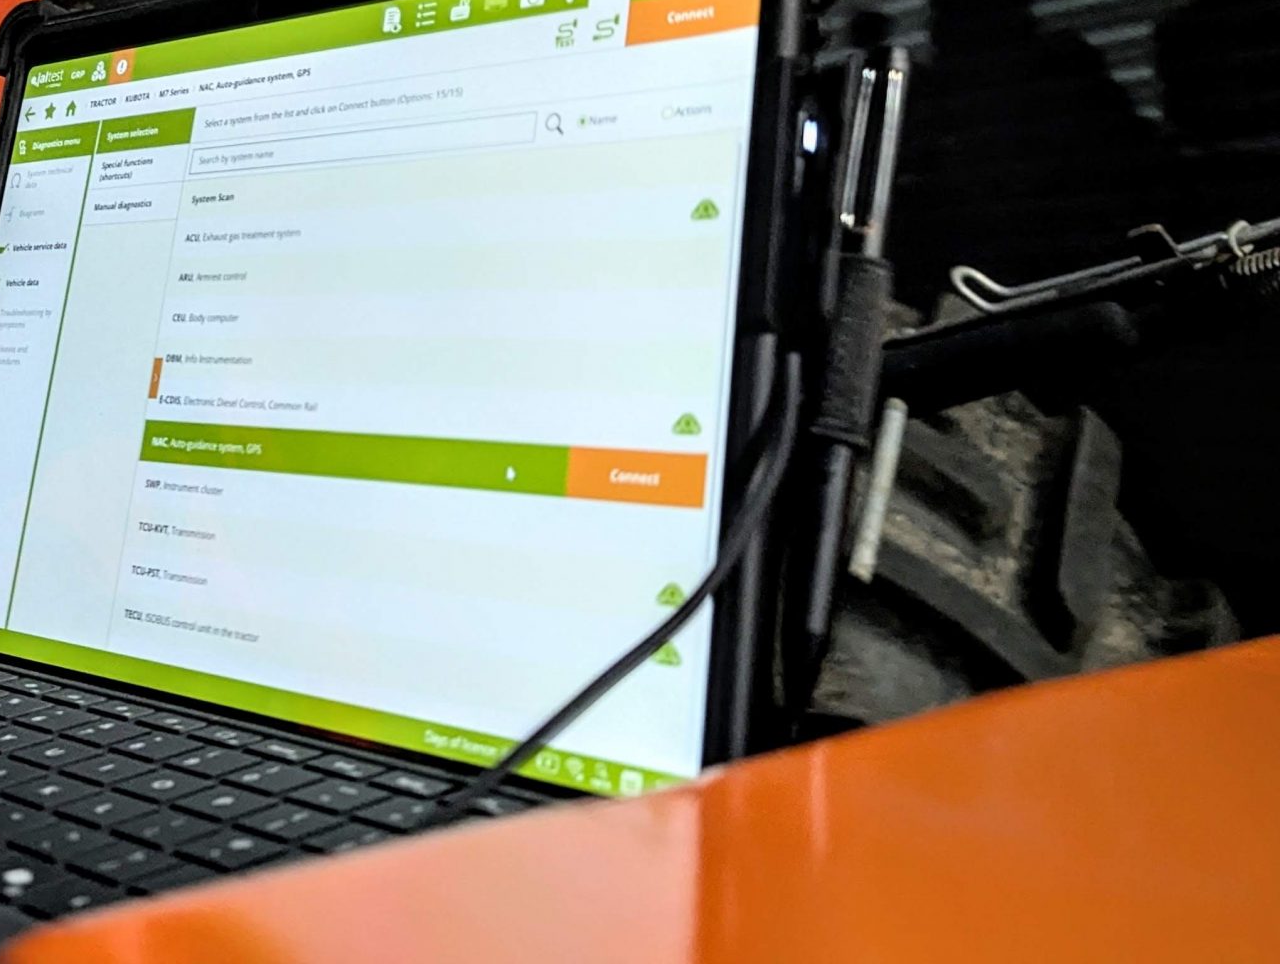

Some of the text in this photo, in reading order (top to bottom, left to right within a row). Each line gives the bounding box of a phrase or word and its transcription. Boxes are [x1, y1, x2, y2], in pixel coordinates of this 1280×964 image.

[666, 6, 715, 25] Connect
[215, 74, 266, 90] Auto-guidance
[267, 70, 295, 84] system,
[296, 67, 311, 78] GPS
[125, 92, 150, 104] KUBOTA
[158, 86, 189, 99] M7 Series
[90, 97, 117, 109] TRACTOR
[204, 118, 223, 129] Select
[229, 116, 253, 128] system
[253, 112, 270, 123] from
[271, 110, 282, 120] the
[283, 108, 294, 118] list
[295, 106, 309, 116] and
[310, 104, 326, 115] click
[327, 105, 337, 113] on
[339, 99, 368, 112] Connect
[369, 96, 396, 108] button
[435, 86, 464, 101] 15/15)
[674, 102, 712, 118] Actions
[588, 113, 618, 127] Name
[106, 127, 158, 142] System selection
[32, 137, 81, 151] Diagnostics menu
[101, 157, 153, 171] Special functions
[198, 154, 221, 165] Search
[230, 151, 254, 163] system
[255, 150, 274, 159] name
[99, 171, 133, 183] (shortcuts)
[94, 199, 152, 212] Manual diagnostics
[191, 192, 235, 206] System Scan
[202, 231, 227, 242] Exhaust
[228, 234, 240, 244] gas
[241, 230, 275, 240] treatment
[276, 229, 301, 239] system
[13, 242, 67, 252] Vehicle service data
[6, 279, 39, 287] Vehicle data
[223, 272, 247, 281] control
[188, 313, 205, 325] Body
[206, 313, 239, 326] computer
[185, 354, 199, 364] Info
[183, 397, 216, 407] Electronic
[217, 397, 238, 409] Diesel
[268, 400, 302, 410] Common
[304, 402, 318, 412] Rail
[171, 437, 217, 452] Auto-guidance
[246, 443, 262, 455] GPS
[609, 467, 661, 487] Connect
[163, 481, 199, 493] Instrument
[200, 484, 223, 496] cluster
[171, 525, 216, 541] Transmission
[163, 570, 208, 586] Transmission
[145, 612, 170, 626] ISOBUS
[172, 618, 196, 631] control
[197, 623, 211, 634] unit
[234, 630, 260, 643] tractor
